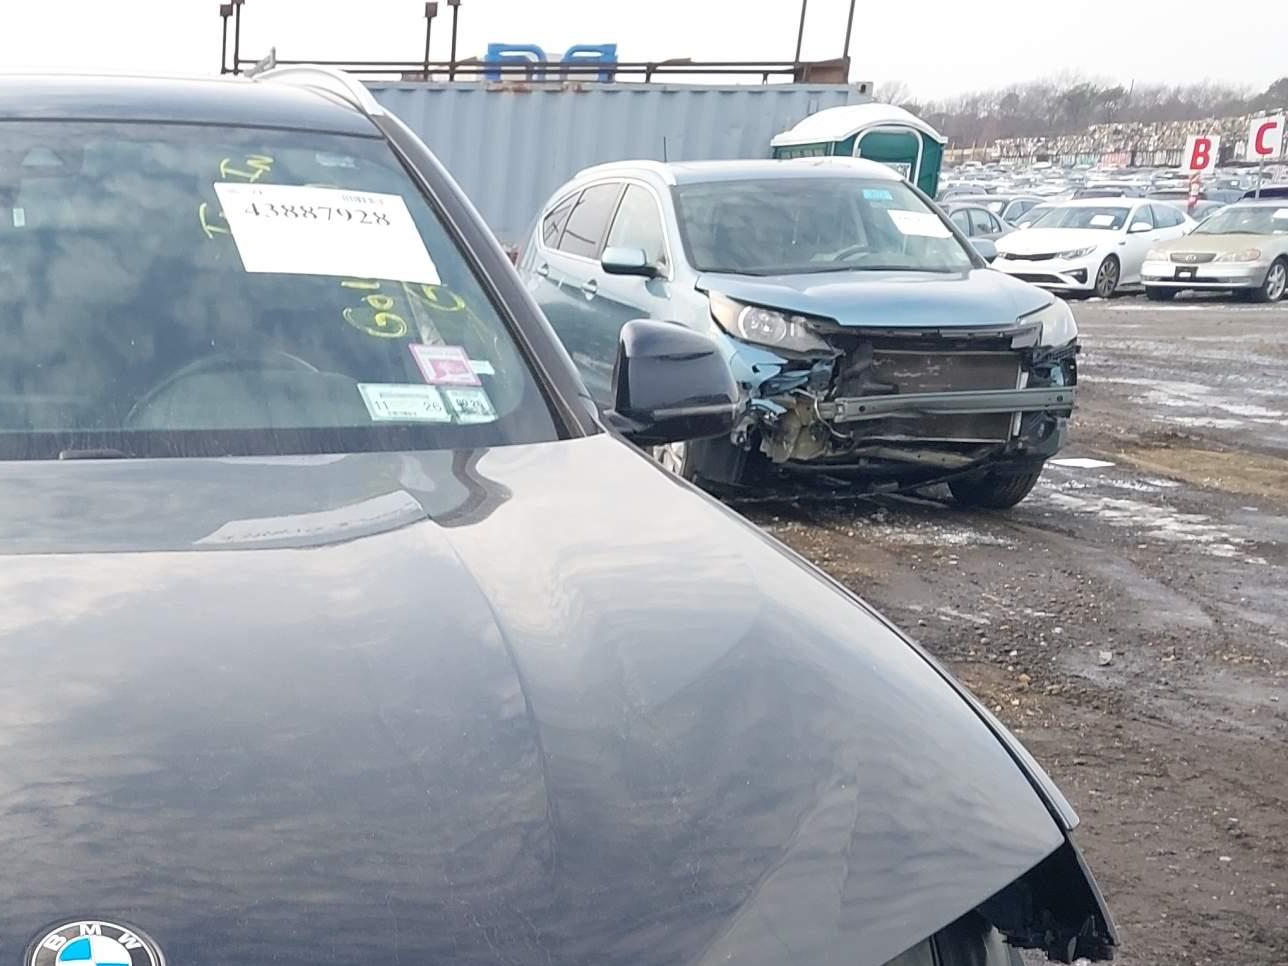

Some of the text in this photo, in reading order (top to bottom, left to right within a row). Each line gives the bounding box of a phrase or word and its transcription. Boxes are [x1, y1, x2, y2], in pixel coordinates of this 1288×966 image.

[1255, 122, 1278, 155] C
[1189, 138, 1213, 171] B
[245, 202, 391, 226] 43887928
[43, 923, 142, 952] BMW
